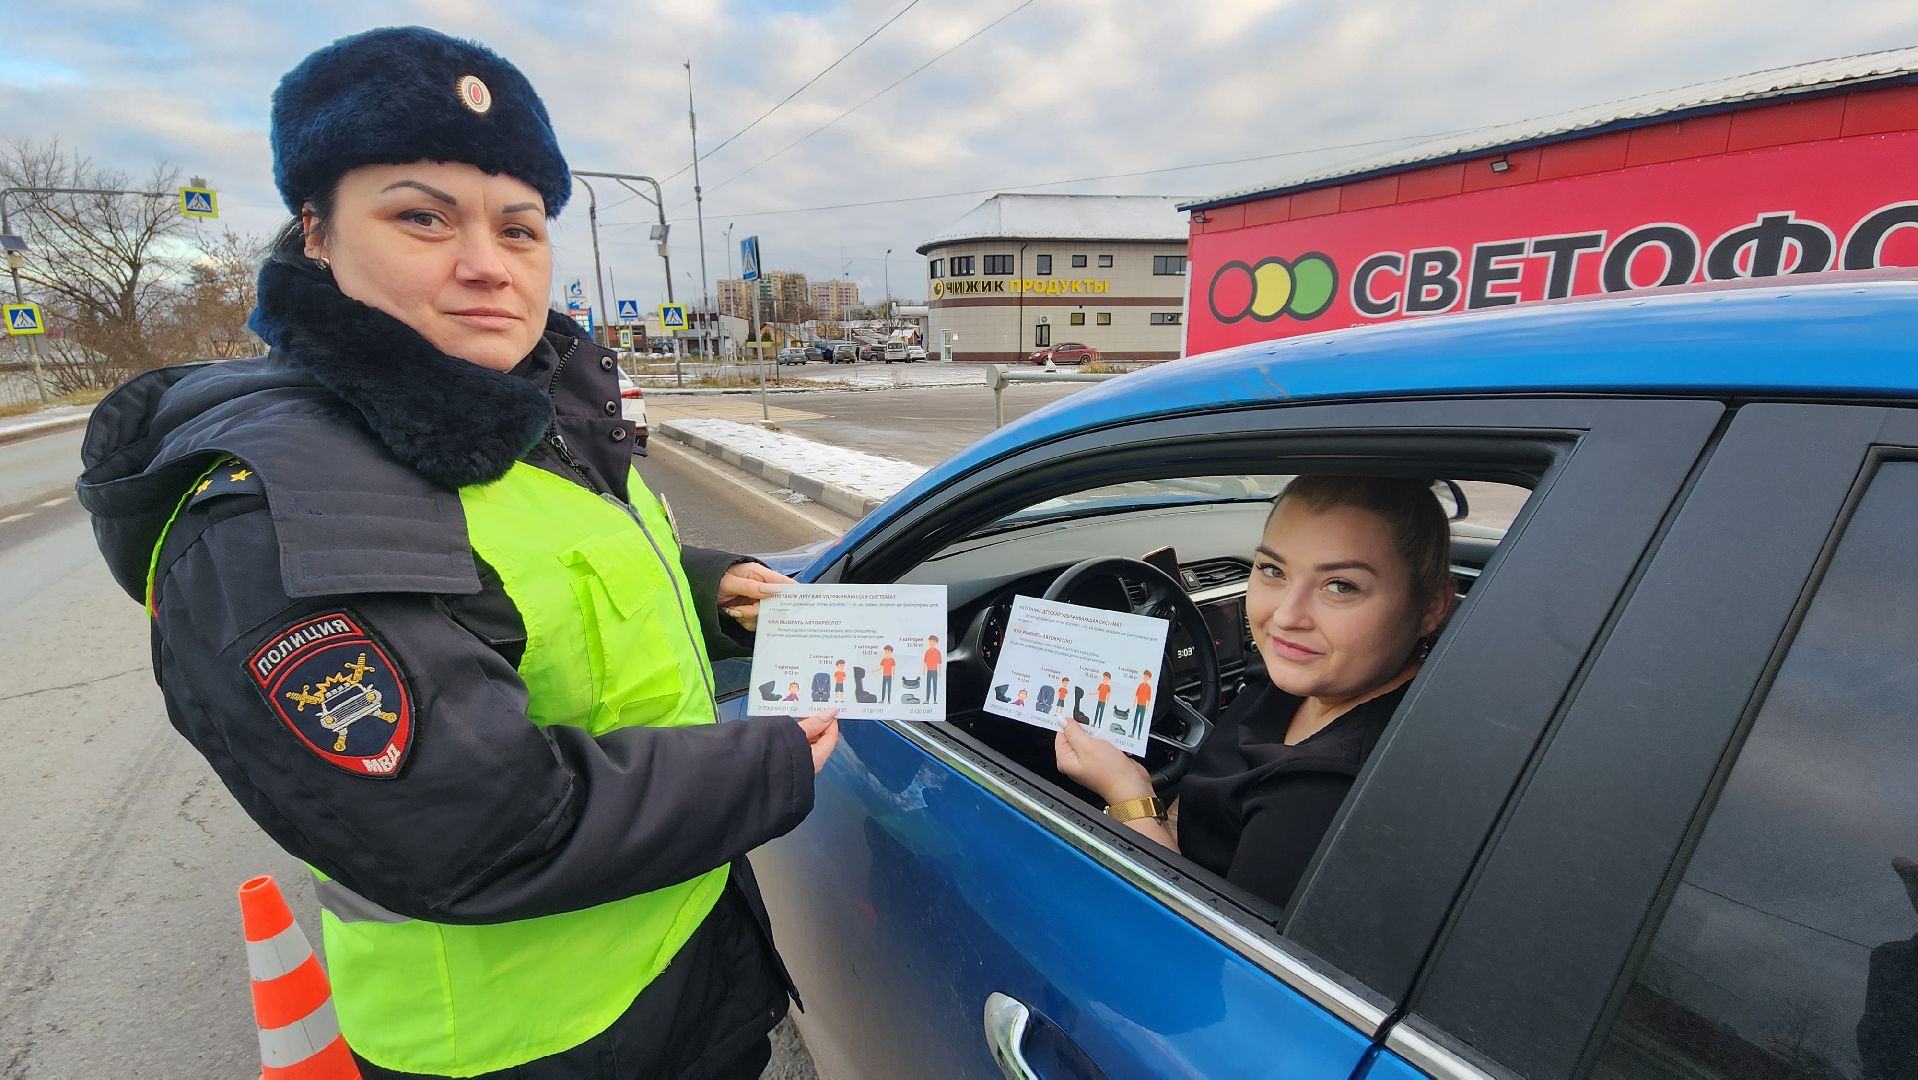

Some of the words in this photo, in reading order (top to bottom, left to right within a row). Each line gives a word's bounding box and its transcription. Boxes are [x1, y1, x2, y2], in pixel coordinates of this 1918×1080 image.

[946, 280, 1005, 295] ЧИЖИК
[1009, 279, 1110, 296] ПРОДУКТЫ
[257, 619, 351, 677] ПОЛИЦИЯ
[361, 743, 400, 773] МВД
